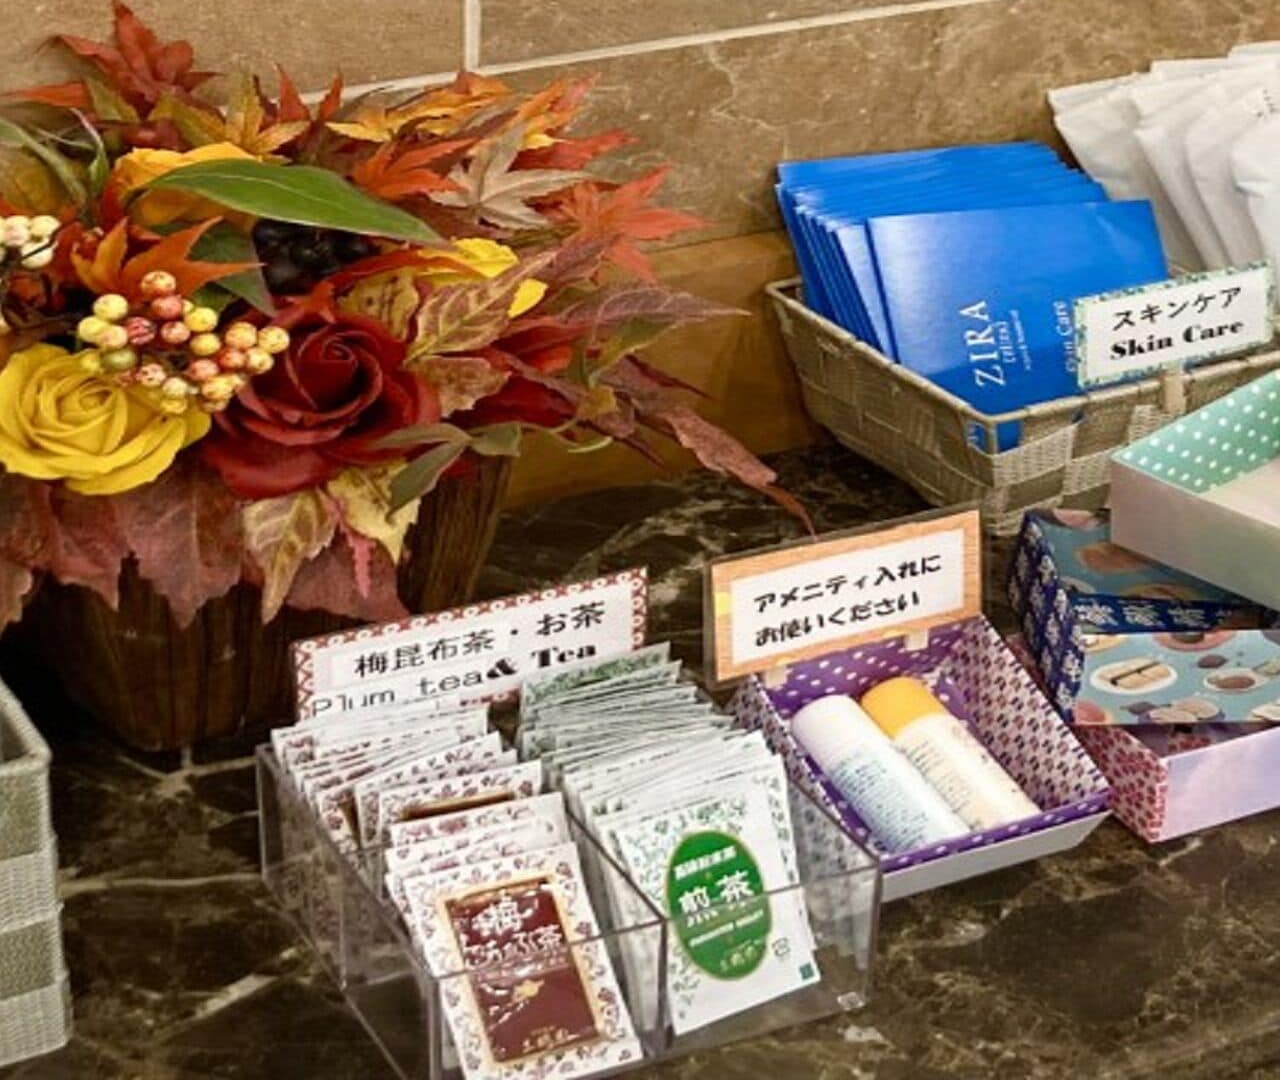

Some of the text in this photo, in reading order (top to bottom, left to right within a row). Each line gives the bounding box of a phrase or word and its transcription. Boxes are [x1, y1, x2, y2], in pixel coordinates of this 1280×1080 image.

[1112, 286, 1242, 332] スキンケア
[959, 300, 1006, 388] ZIRA
[1110, 319, 1245, 360] Skin Care
[753, 555, 942, 613] アメニティ入れに
[354, 600, 606, 677] 梅昆布茶・お茶
[754, 590, 921, 647] お使いください
[311, 689, 396, 717] Plum
[416, 669, 483, 696] tea
[529, 644, 598, 669] Tea
[678, 870, 755, 929] 煎茶
